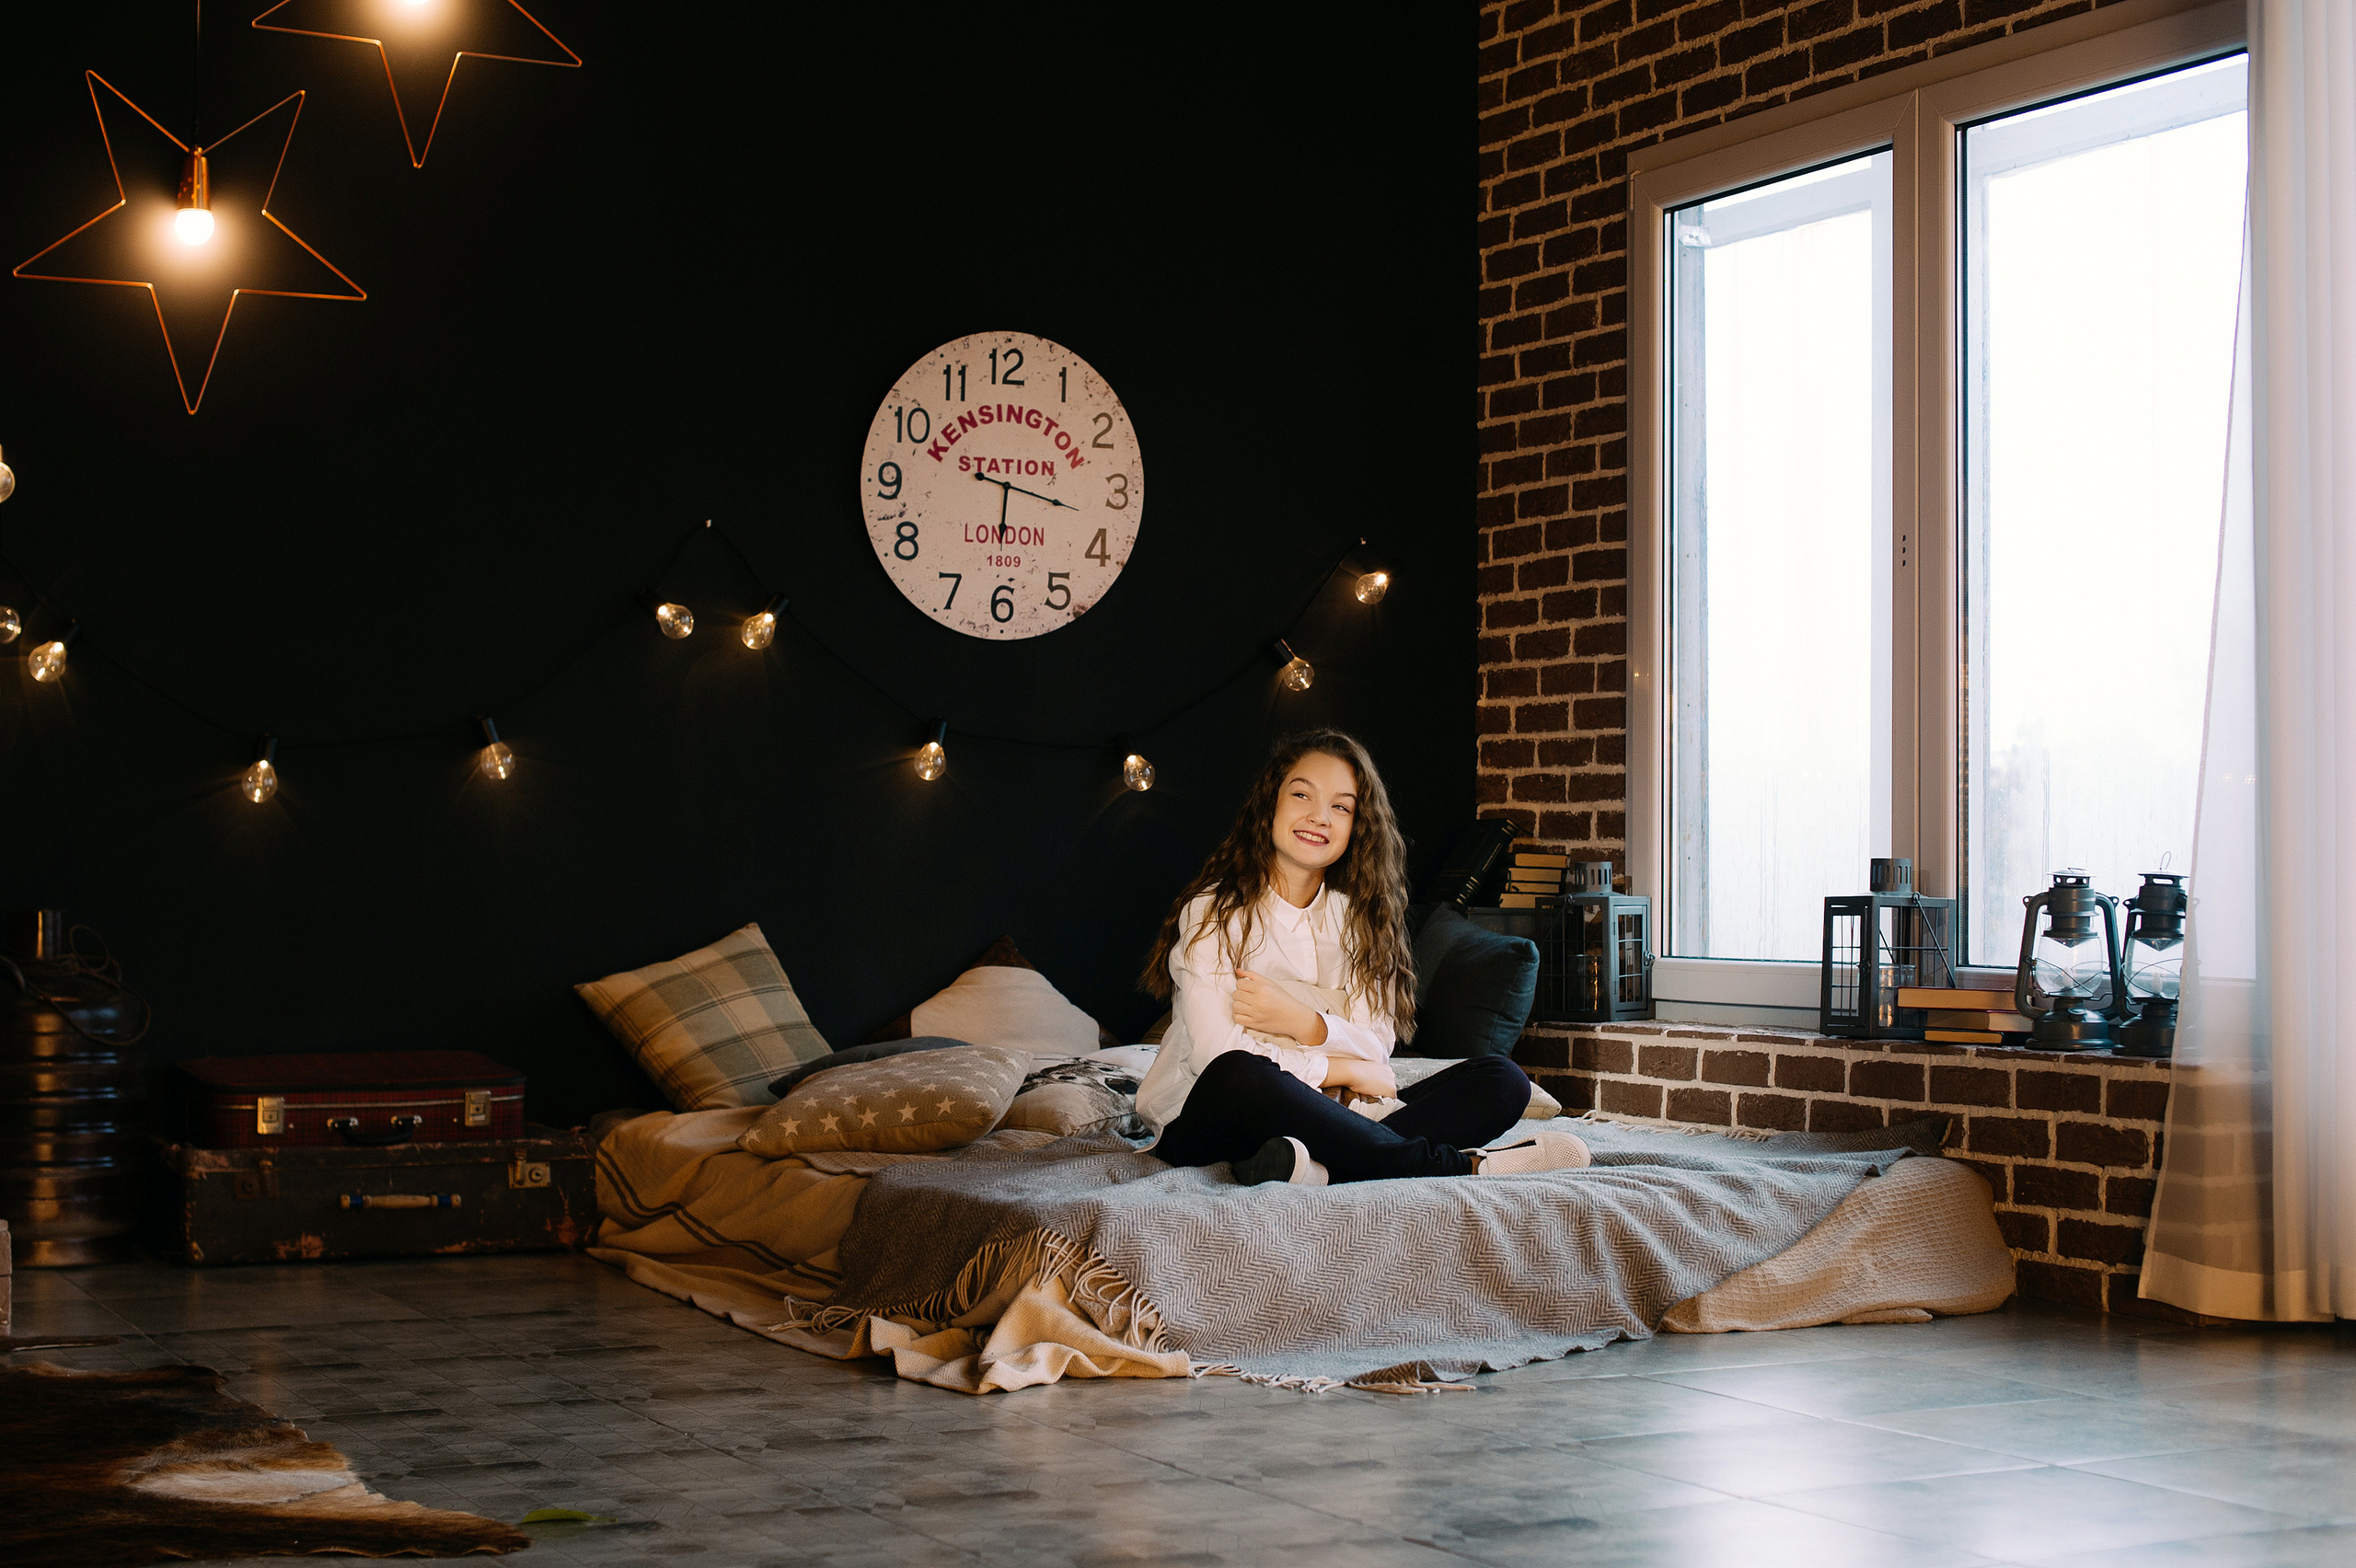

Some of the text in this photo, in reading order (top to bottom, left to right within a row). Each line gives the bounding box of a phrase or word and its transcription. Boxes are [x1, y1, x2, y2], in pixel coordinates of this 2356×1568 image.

[942, 364, 966, 402] 11
[988, 348, 1024, 386] 12
[1058, 366, 1067, 402] 1
[895, 406, 930, 444] 10
[927, 404, 1085, 469] KENSINGTON
[1091, 412, 1114, 449] 2
[877, 462, 903, 500] 9
[958, 455, 1055, 476] STATION
[1105, 473, 1128, 510] 3
[894, 521, 919, 560] 8
[964, 523, 1045, 546] LONDON
[1084, 528, 1111, 567] 4
[987, 555, 1021, 567] 1809
[939, 571, 962, 610] 7
[990, 584, 1015, 623] 6
[1044, 571, 1071, 610] 5
